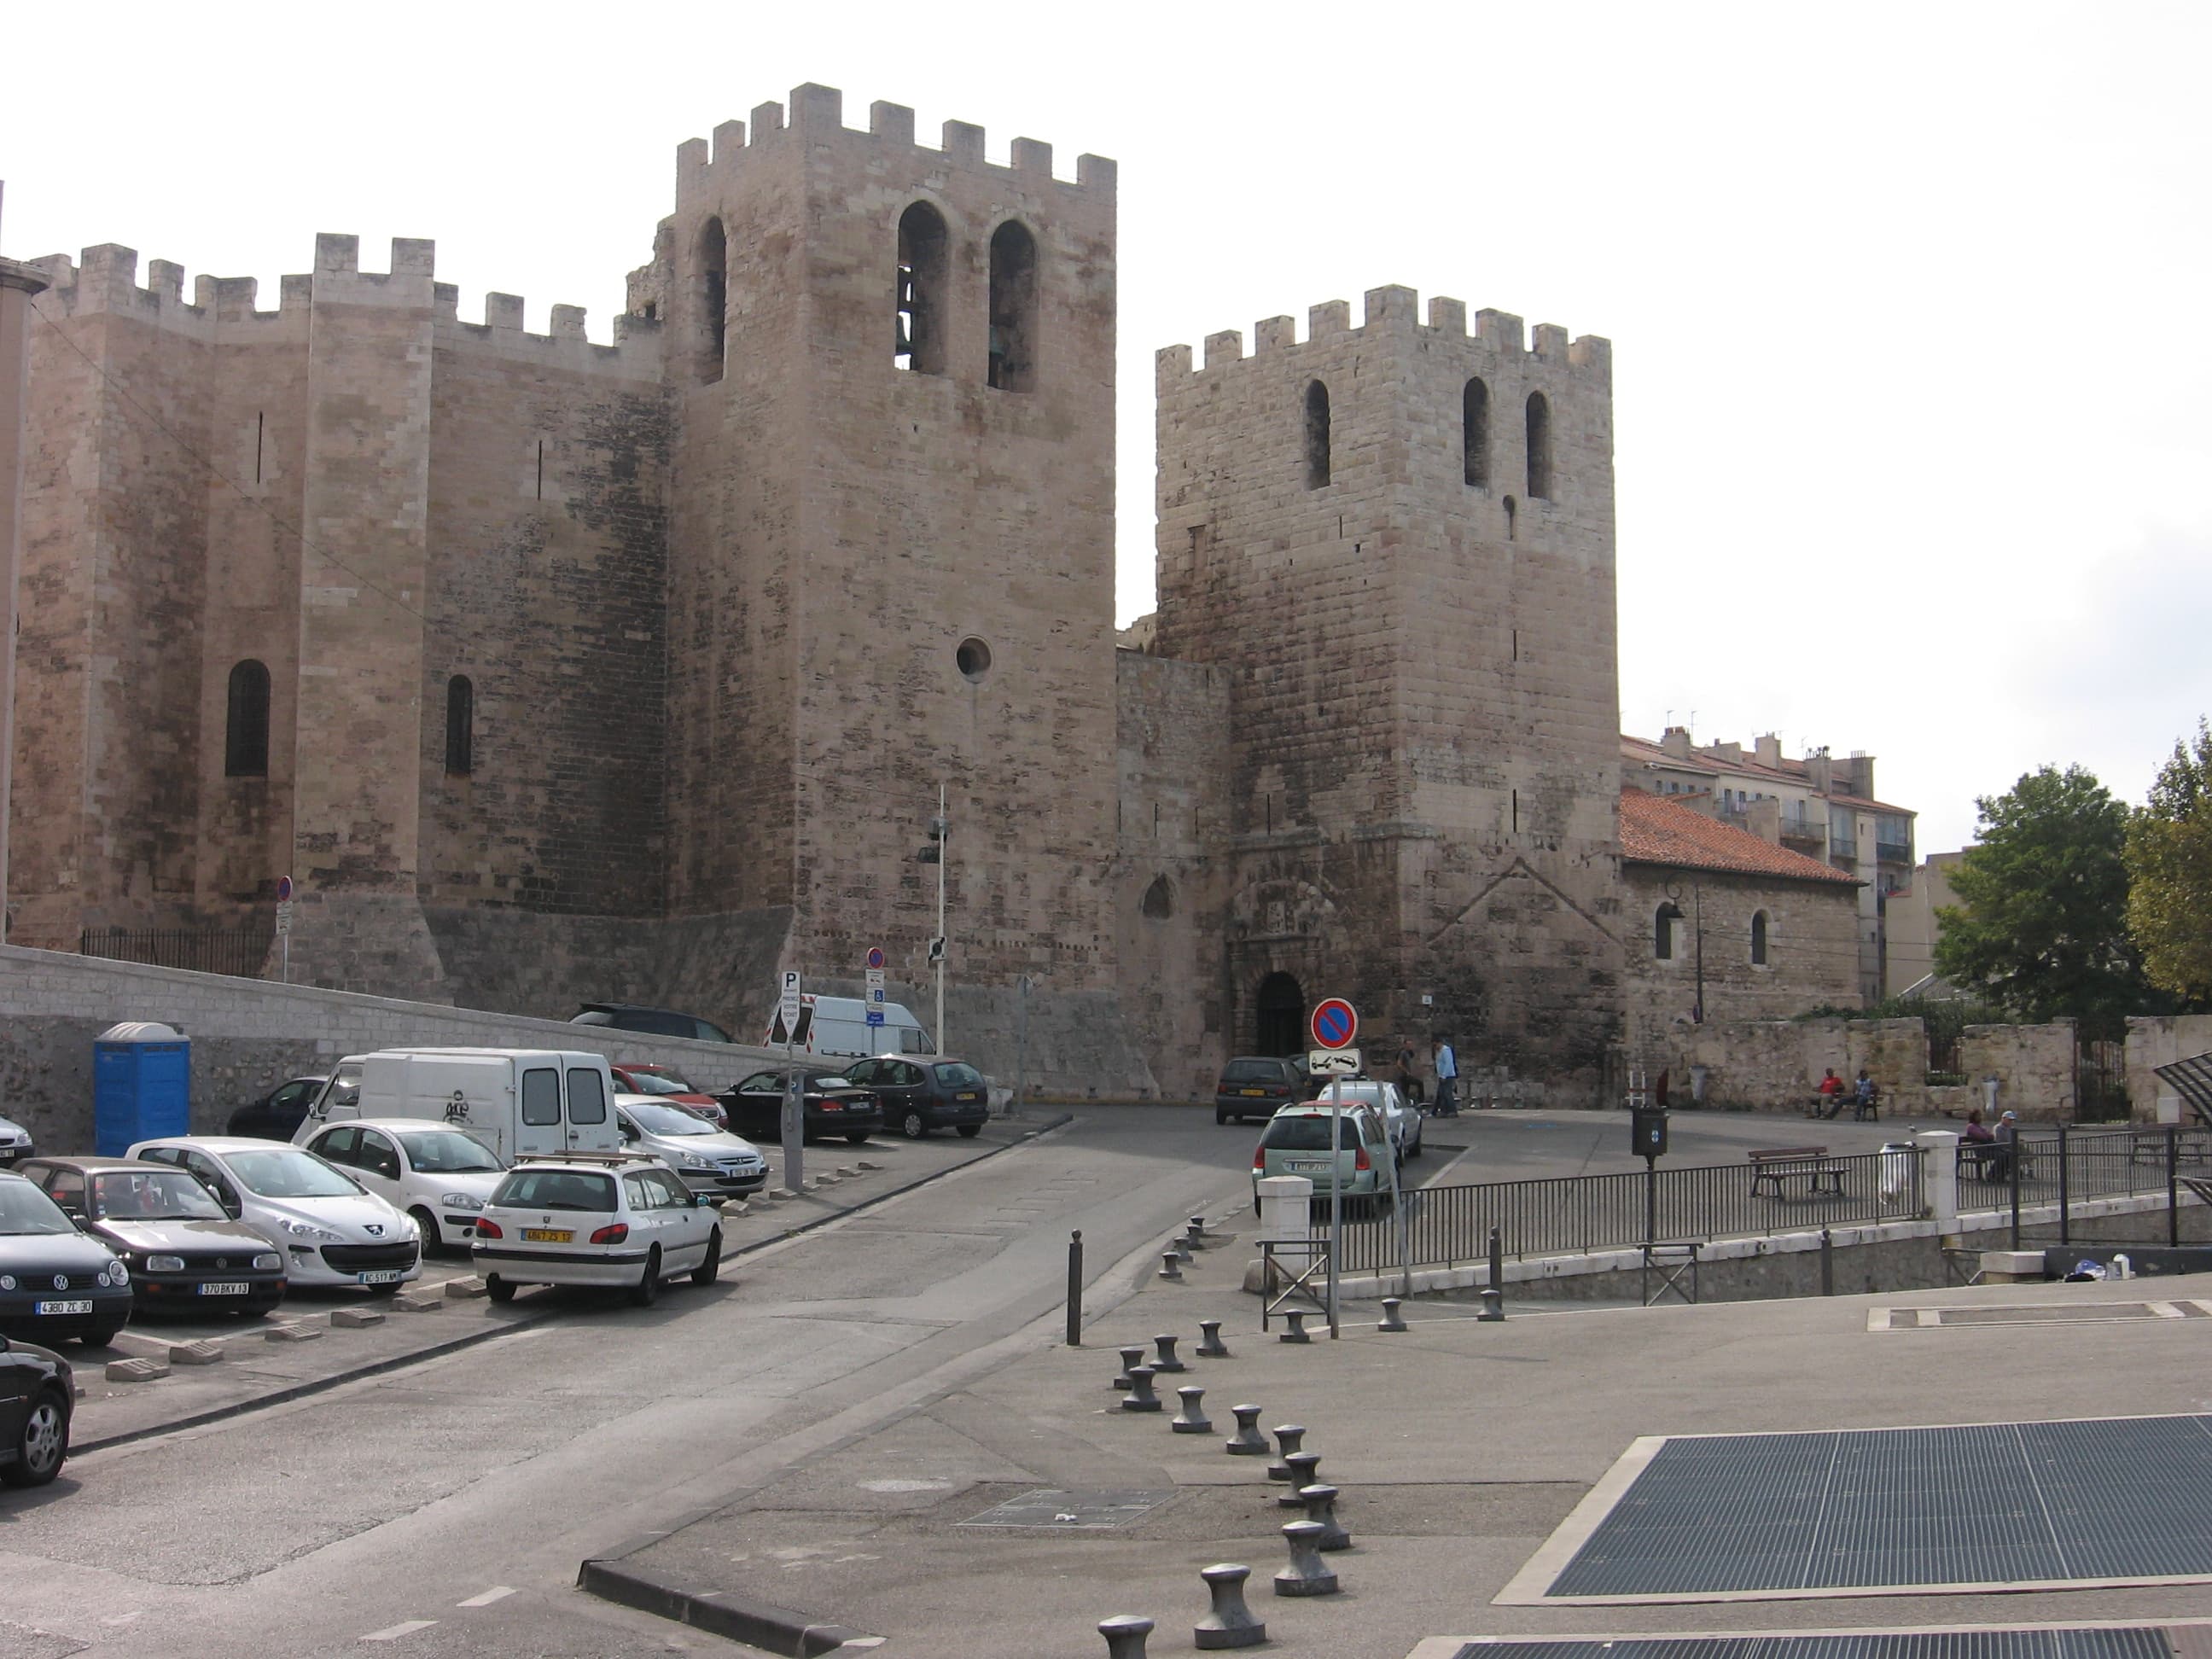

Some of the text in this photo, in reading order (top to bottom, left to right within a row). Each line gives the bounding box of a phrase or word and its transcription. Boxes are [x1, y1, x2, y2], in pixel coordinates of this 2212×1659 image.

[786, 972, 796, 987] P
[238, 1284, 247, 1293] 13
[80, 1301, 91, 1312] 30
